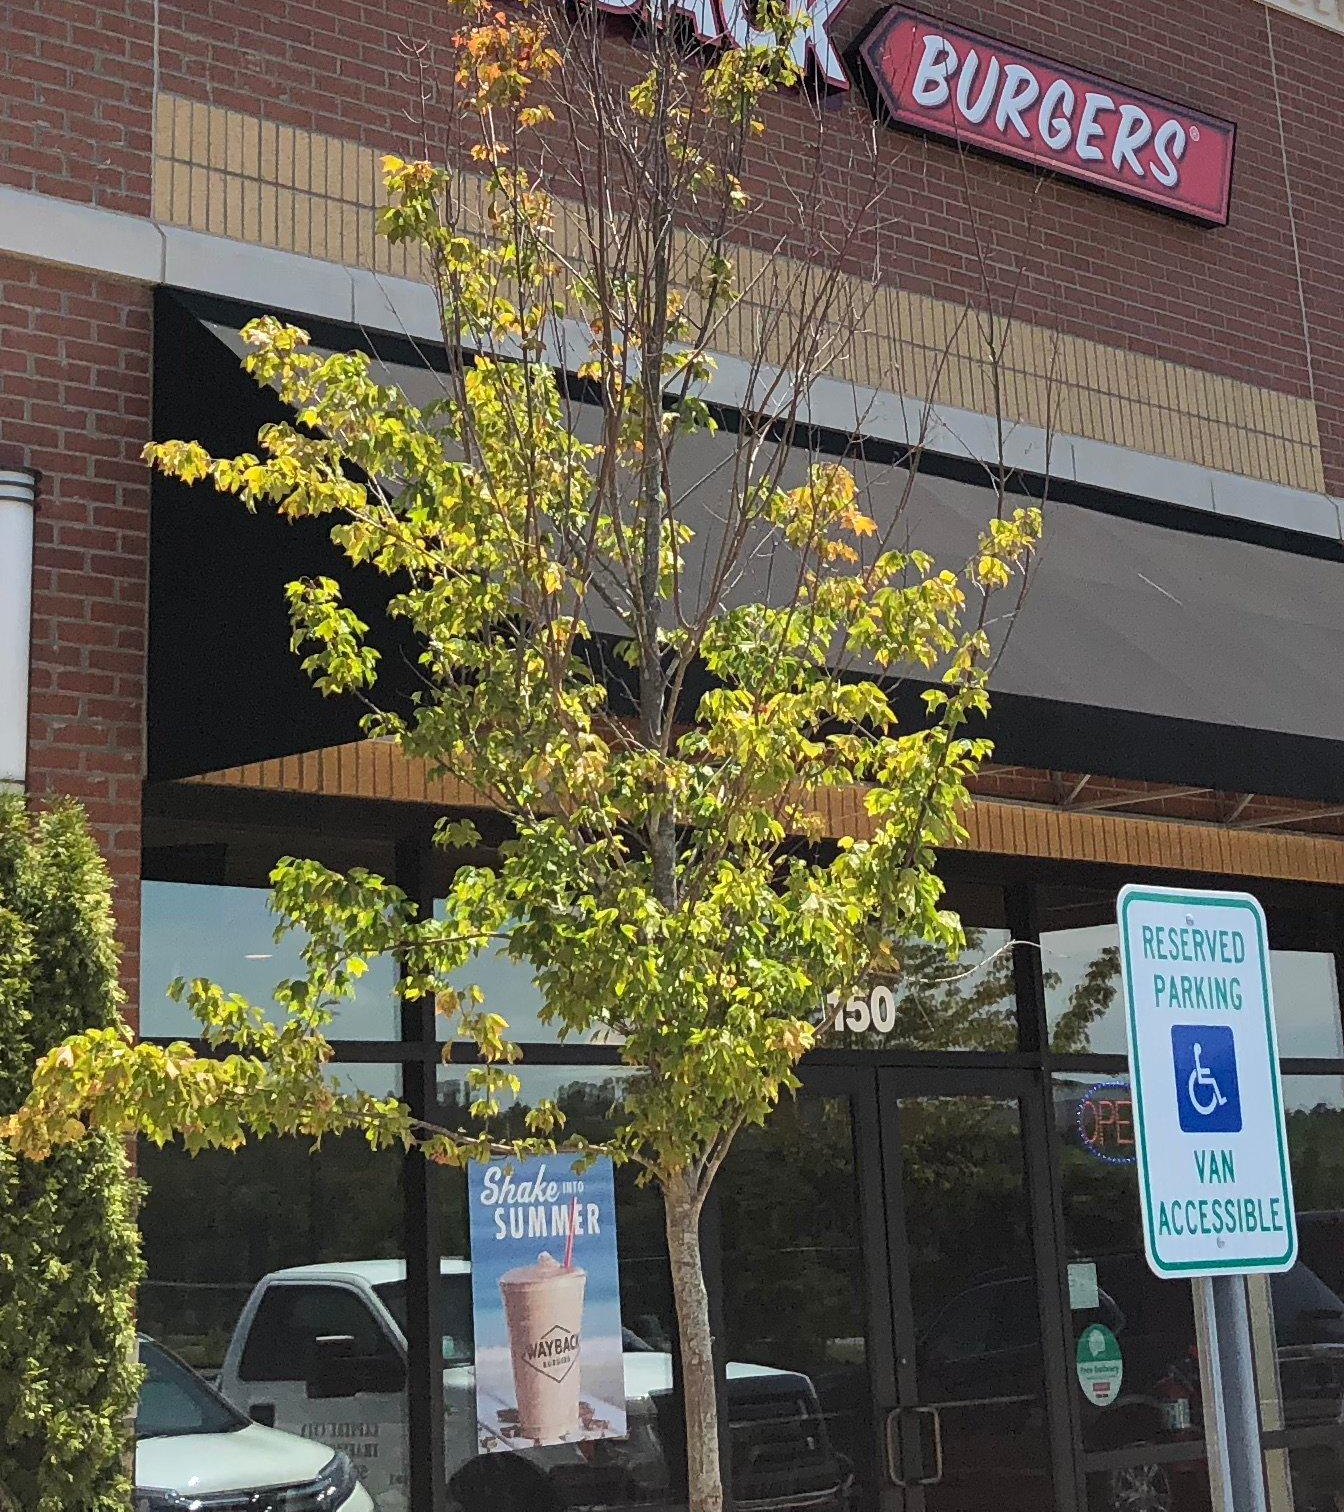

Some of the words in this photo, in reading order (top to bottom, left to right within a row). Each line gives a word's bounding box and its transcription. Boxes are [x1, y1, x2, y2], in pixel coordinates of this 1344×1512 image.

[911, 33, 1187, 190] BURGERS
[1141, 924, 1246, 965] RESERVED
[1153, 973, 1244, 1011] PARKING
[1083, 1099, 1134, 1147] OPE
[480, 1163, 561, 1207] Shake
[1193, 1149, 1236, 1185] VAN
[493, 1202, 602, 1241] SUMMER
[1158, 1196, 1284, 1237] ACCESSIBLE
